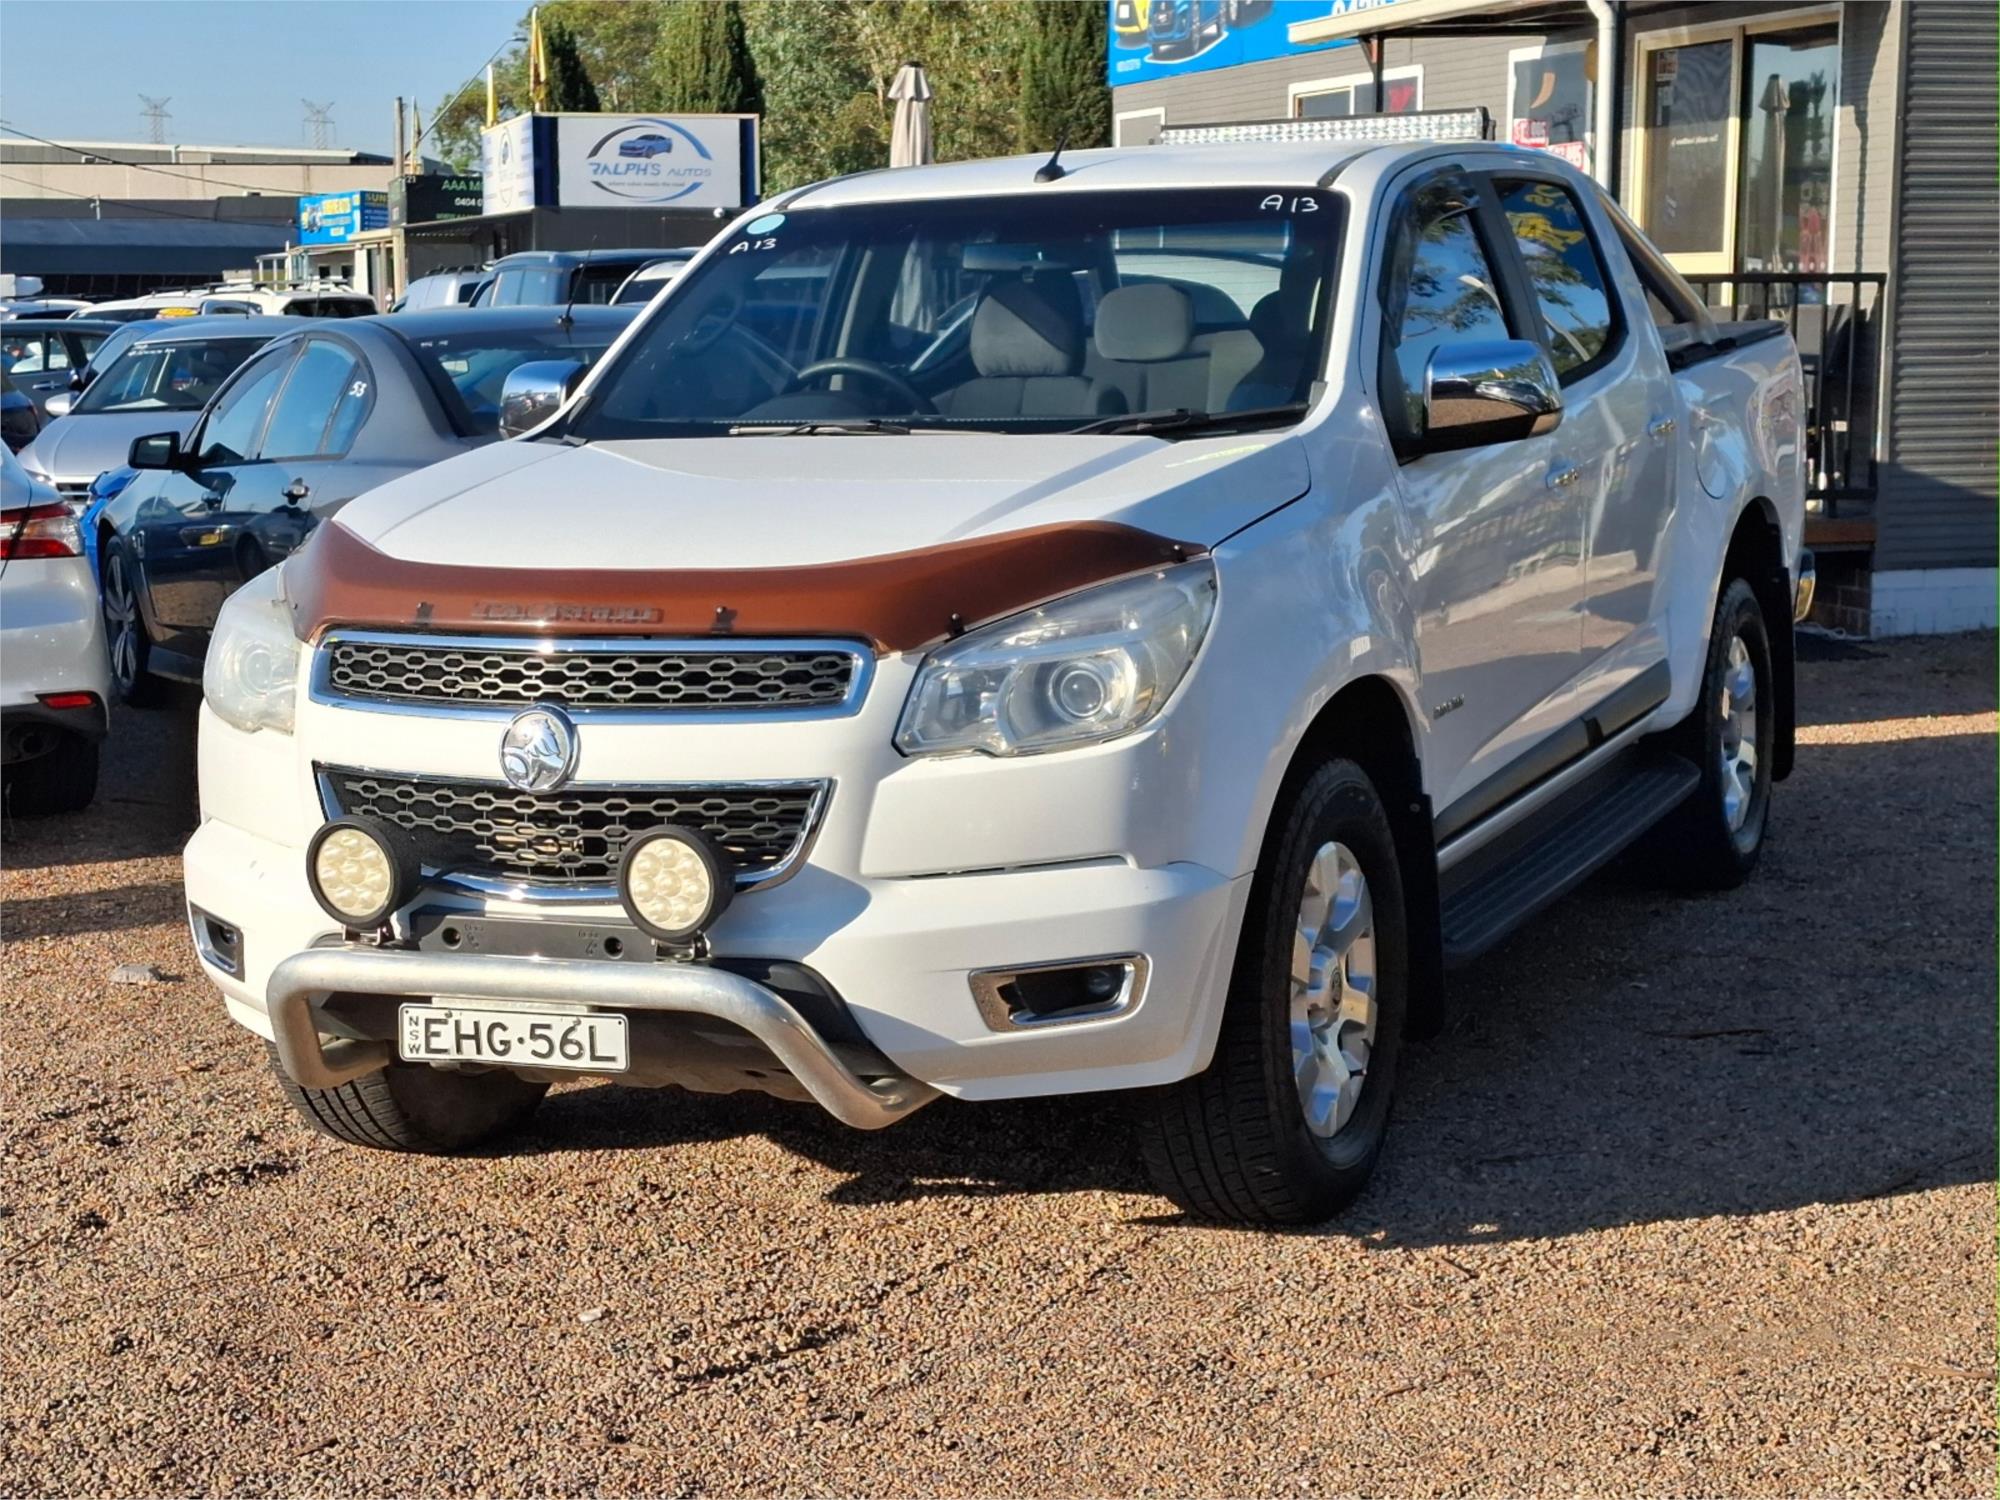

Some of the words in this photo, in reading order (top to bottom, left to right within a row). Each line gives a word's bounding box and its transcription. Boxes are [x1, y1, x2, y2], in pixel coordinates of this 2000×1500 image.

[588, 162, 662, 177] RALPH'S
[667, 167, 712, 177] AUTOS
[442, 179, 467, 191] AAA
